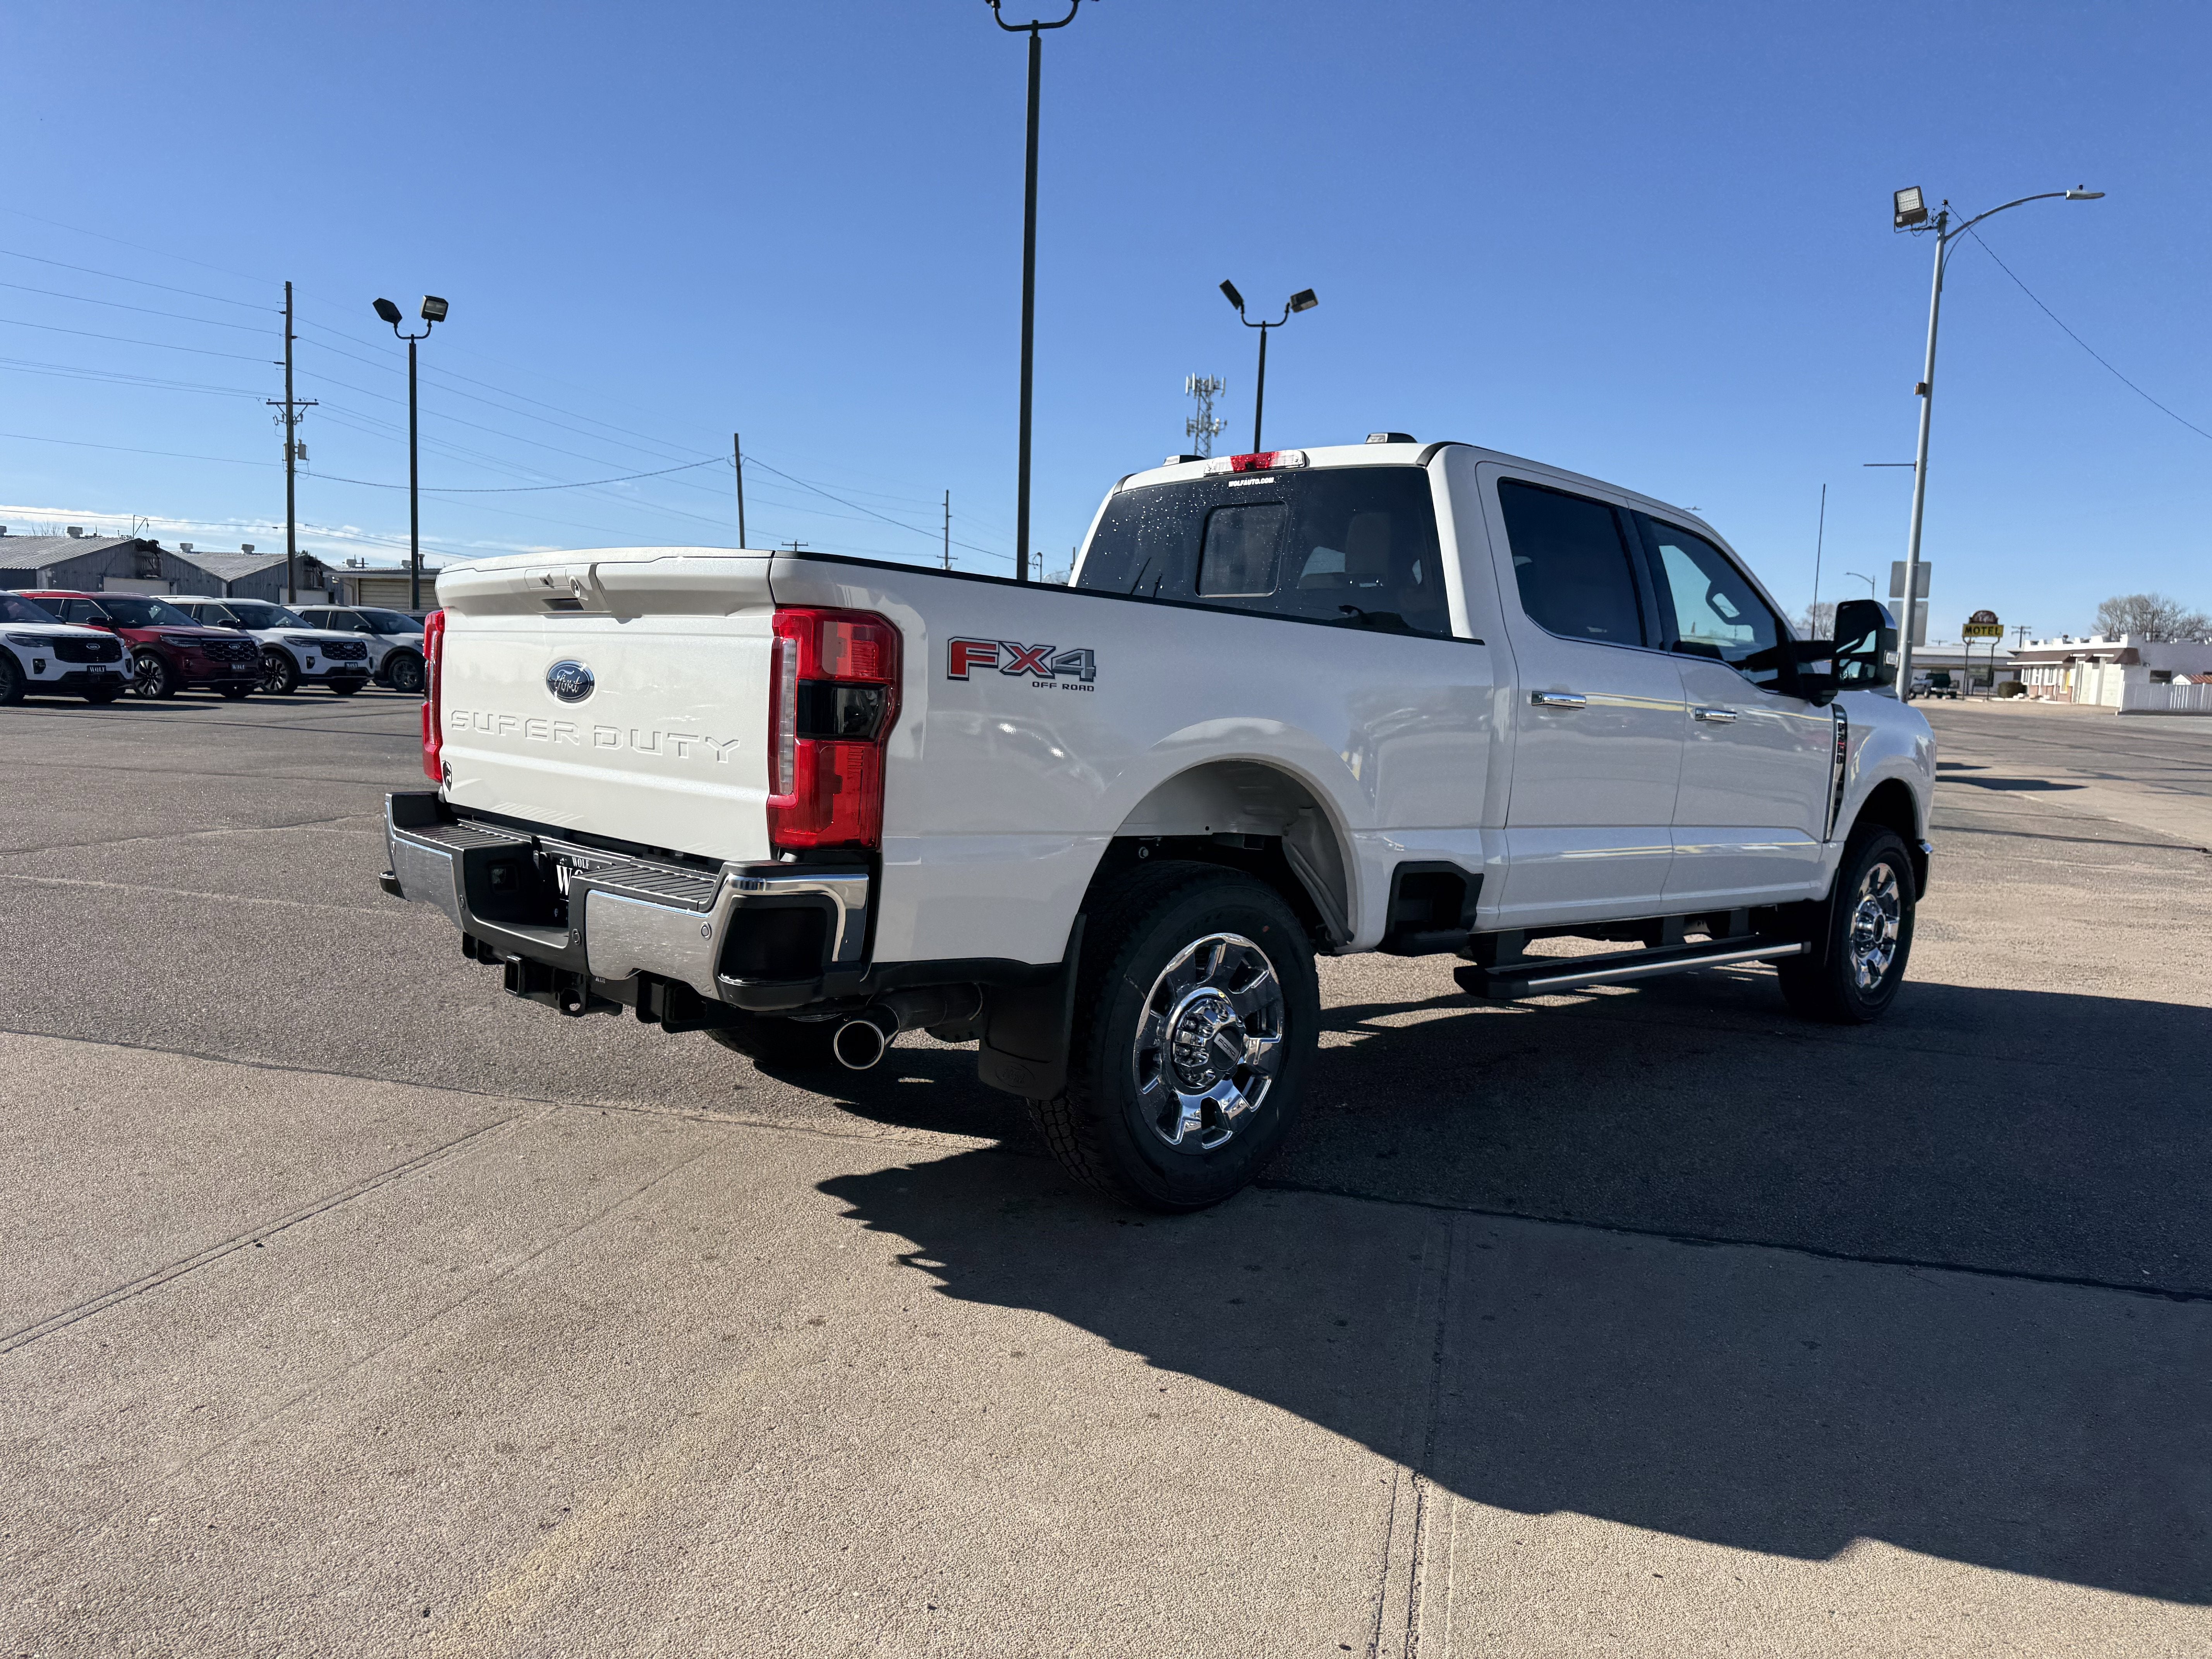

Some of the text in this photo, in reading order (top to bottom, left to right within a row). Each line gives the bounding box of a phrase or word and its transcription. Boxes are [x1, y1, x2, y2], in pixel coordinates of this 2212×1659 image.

[1228, 477, 1274, 487] WOLFAUTO.COM
[1965, 626, 2001, 635] MOTEL
[947, 636, 1096, 682] FX4
[554, 669, 582, 693] Ford
[1062, 684, 1094, 692] ROAD
[451, 710, 740, 763] SUPER DUTY
[572, 856, 590, 870] WOLF
[1218, 1038, 1236, 1057] FORD
